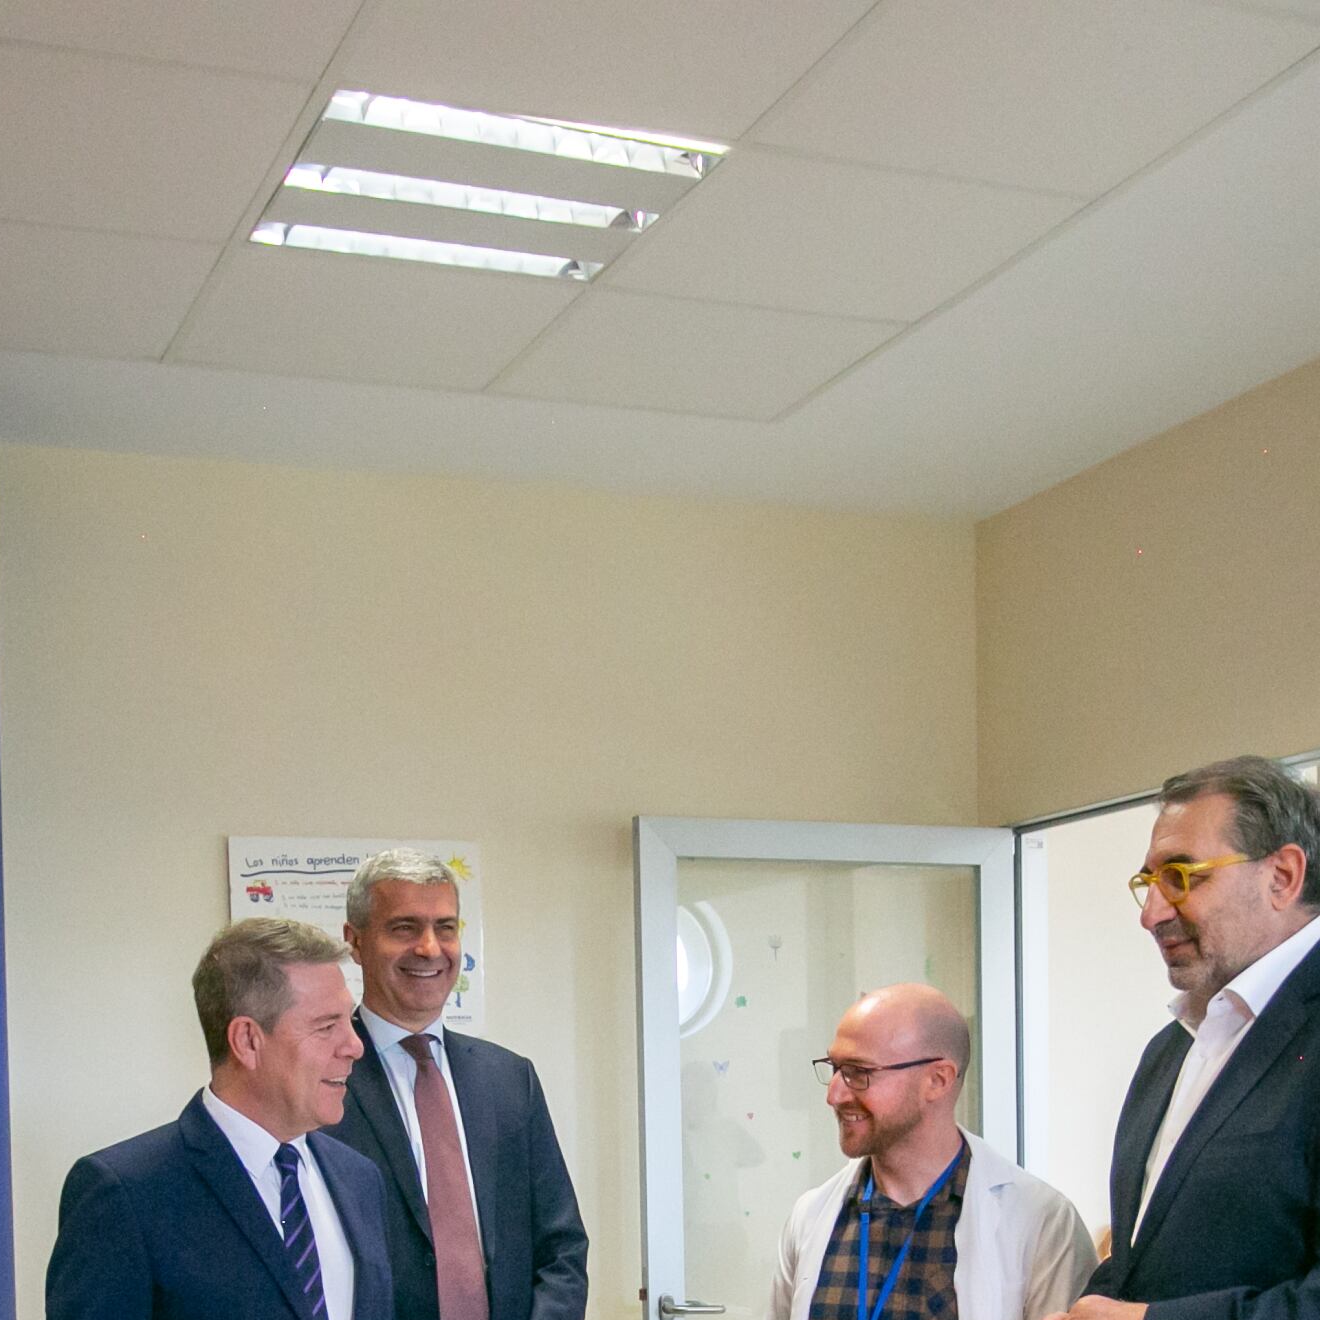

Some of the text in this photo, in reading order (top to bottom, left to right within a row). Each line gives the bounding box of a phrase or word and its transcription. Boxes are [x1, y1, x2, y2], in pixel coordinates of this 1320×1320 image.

[245, 853, 360, 870] Los niños aprenden
